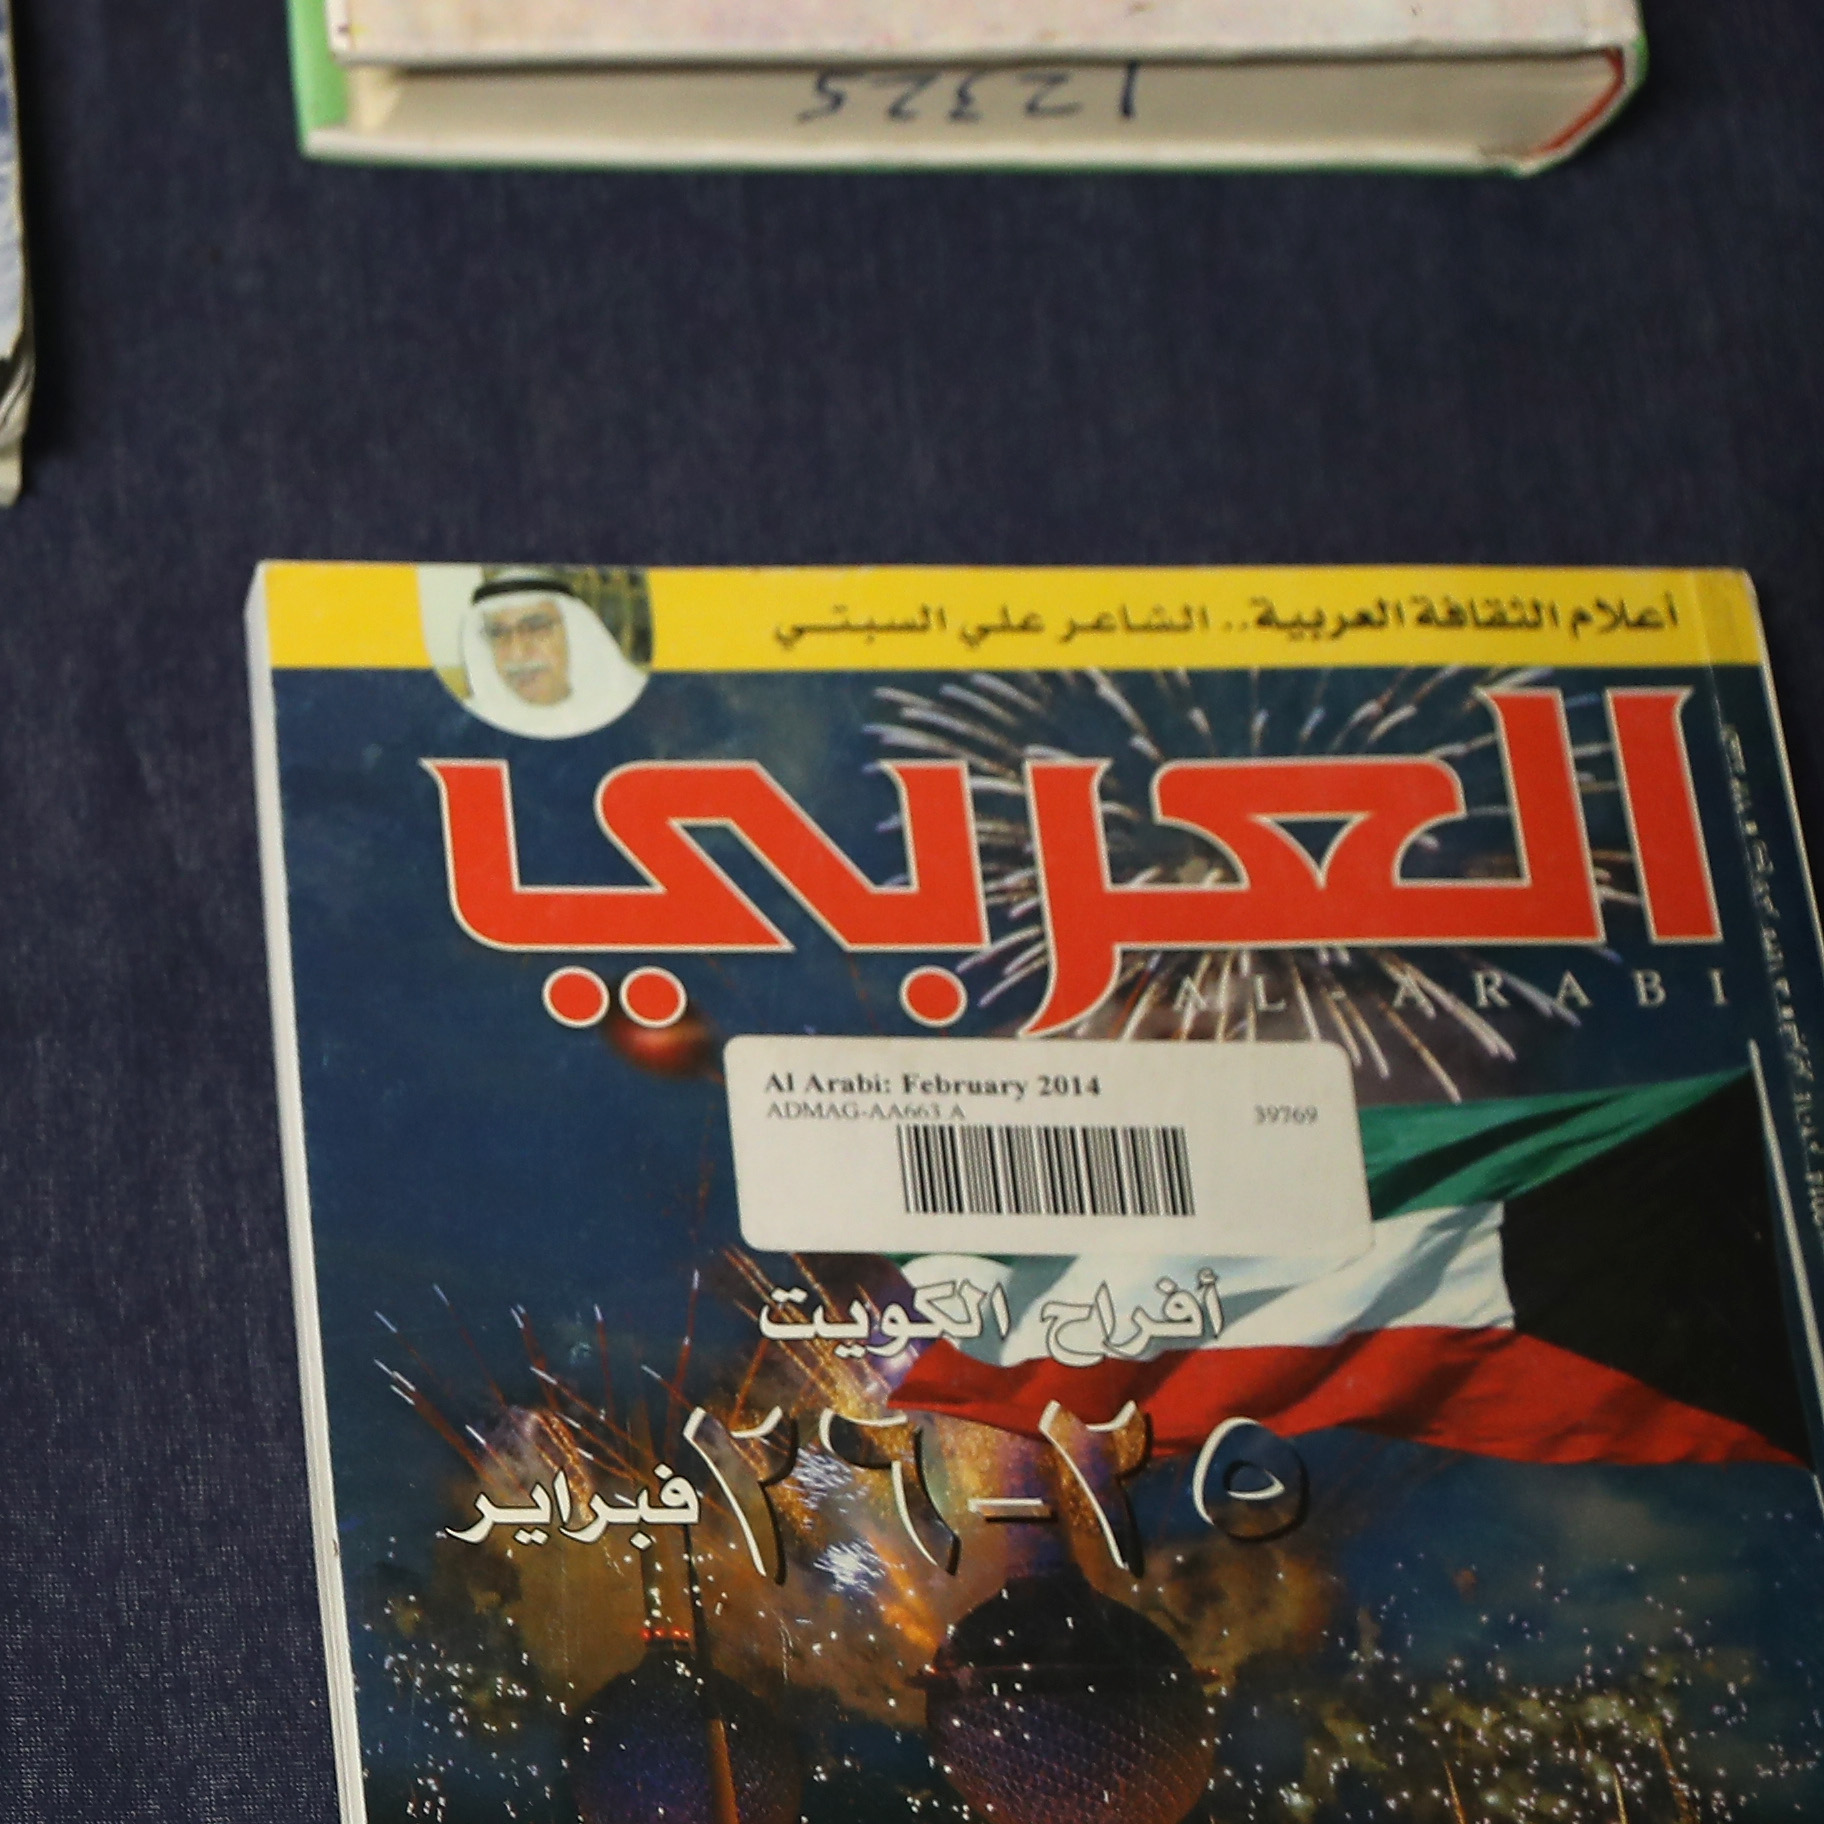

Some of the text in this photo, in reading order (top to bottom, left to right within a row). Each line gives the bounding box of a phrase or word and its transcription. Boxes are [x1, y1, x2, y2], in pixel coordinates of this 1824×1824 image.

[959, 606, 1044, 649] علي
[1057, 604, 1209, 646] الشاعر
[1416, 596, 1557, 640] الثقافة
[419, 685, 1724, 1037] العربي
[765, 1073, 1101, 1101] Al Arabi: February 2014
[950, 1103, 966, 1120] A
[1253, 1105, 1318, 1126] 39769
[757, 1267, 1226, 1367] أفراح الكويت
[445, 1463, 703, 1546] فبراير
